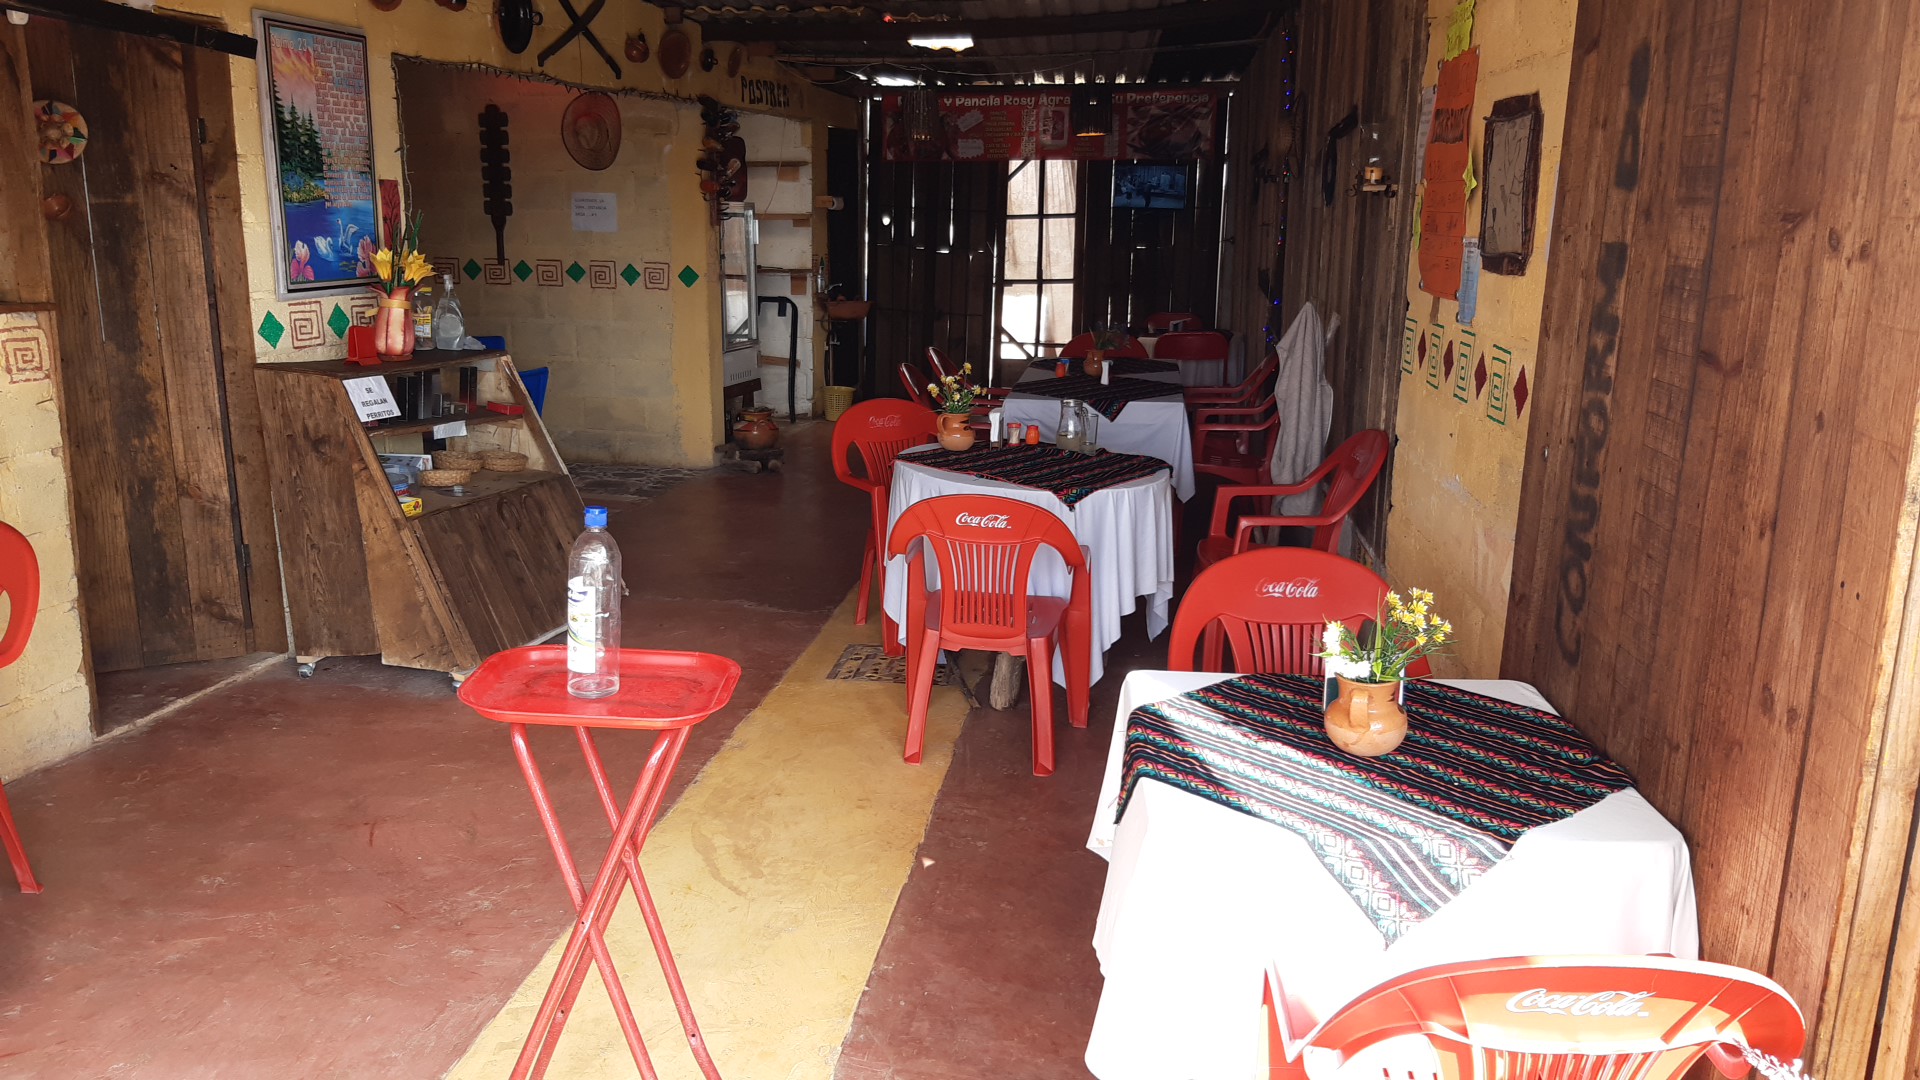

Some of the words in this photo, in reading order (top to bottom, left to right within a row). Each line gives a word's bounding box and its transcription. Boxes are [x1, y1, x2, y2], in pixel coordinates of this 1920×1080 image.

[271, 33, 294, 49] Salmo
[943, 97, 953, 106] Y
[1003, 94, 1035, 109] Rosy
[1126, 92, 1209, 105] Preferencia
[364, 386, 374, 395] SE
[361, 398, 388, 408] REGALAN
[366, 409, 395, 420] PERRITOS
